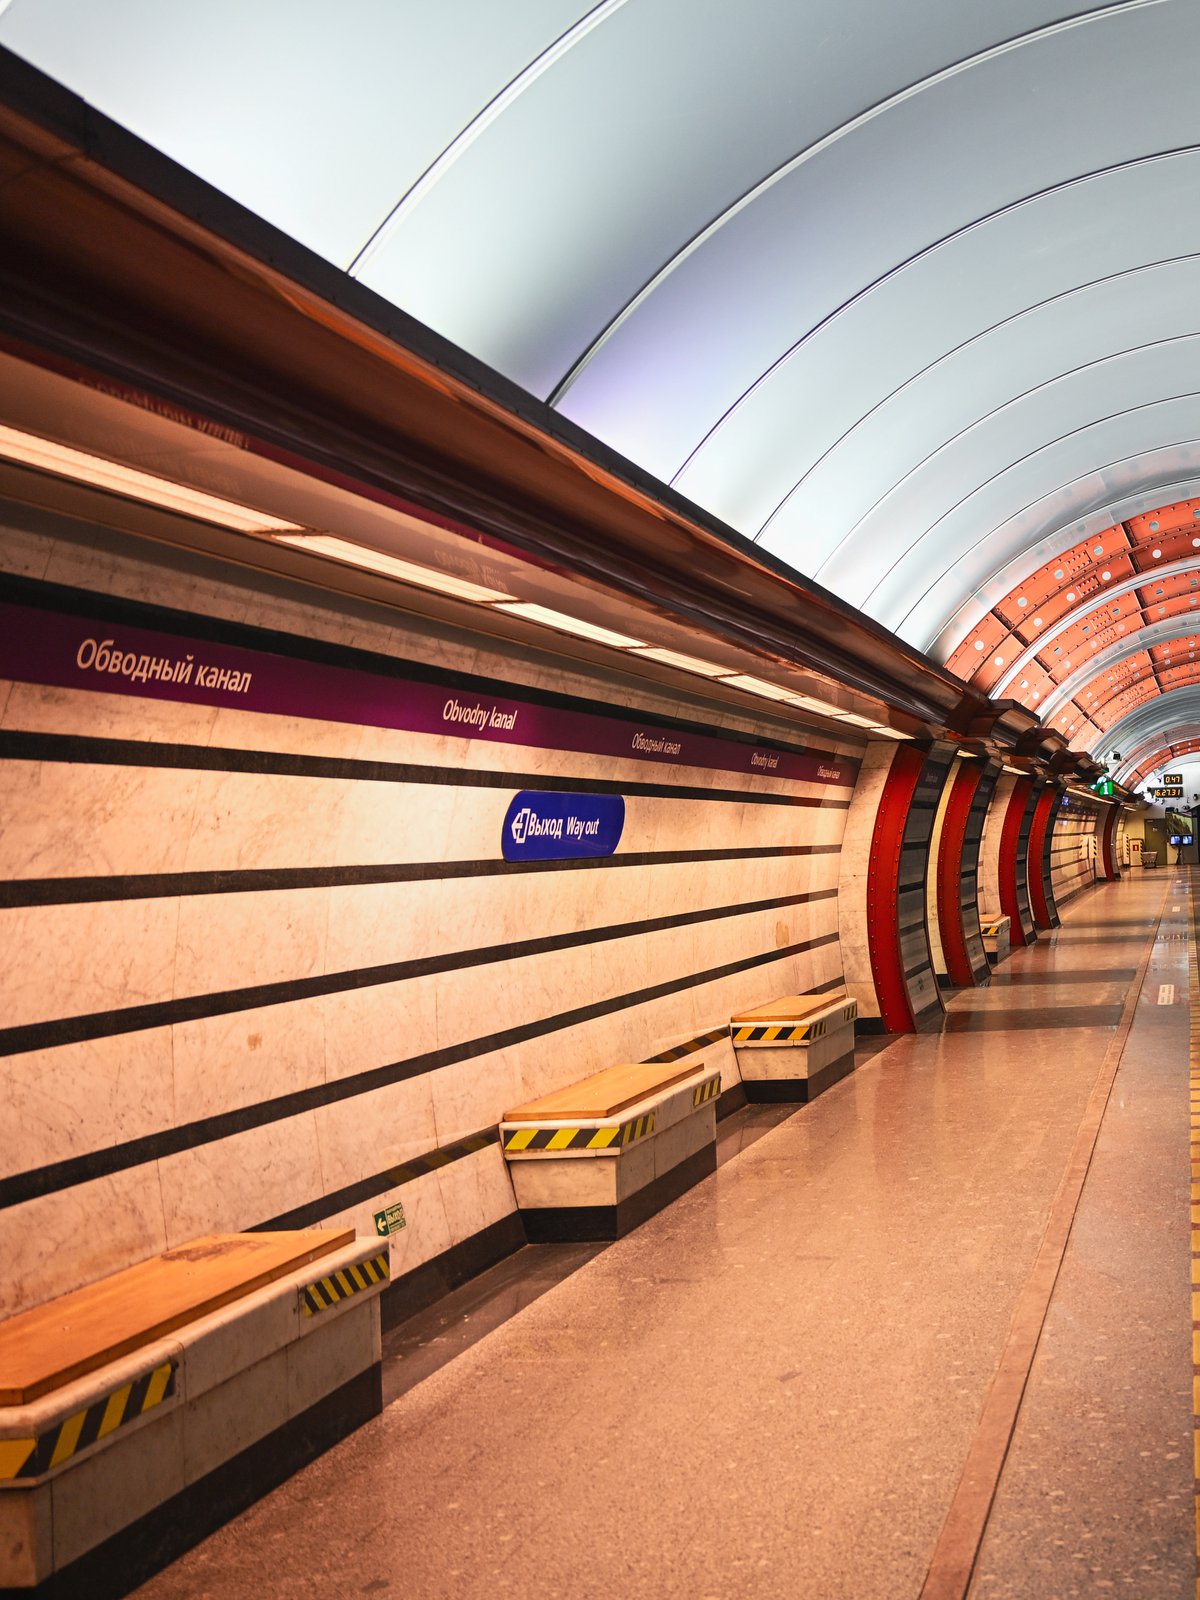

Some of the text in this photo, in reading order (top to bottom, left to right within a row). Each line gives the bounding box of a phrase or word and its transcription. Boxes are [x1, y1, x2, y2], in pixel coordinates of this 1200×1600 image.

[77, 638, 252, 693] Обводный канал
[443, 699, 518, 731] Obvodny kanal
[528, 813, 564, 839] Выход
[566, 816, 600, 840] Way out
